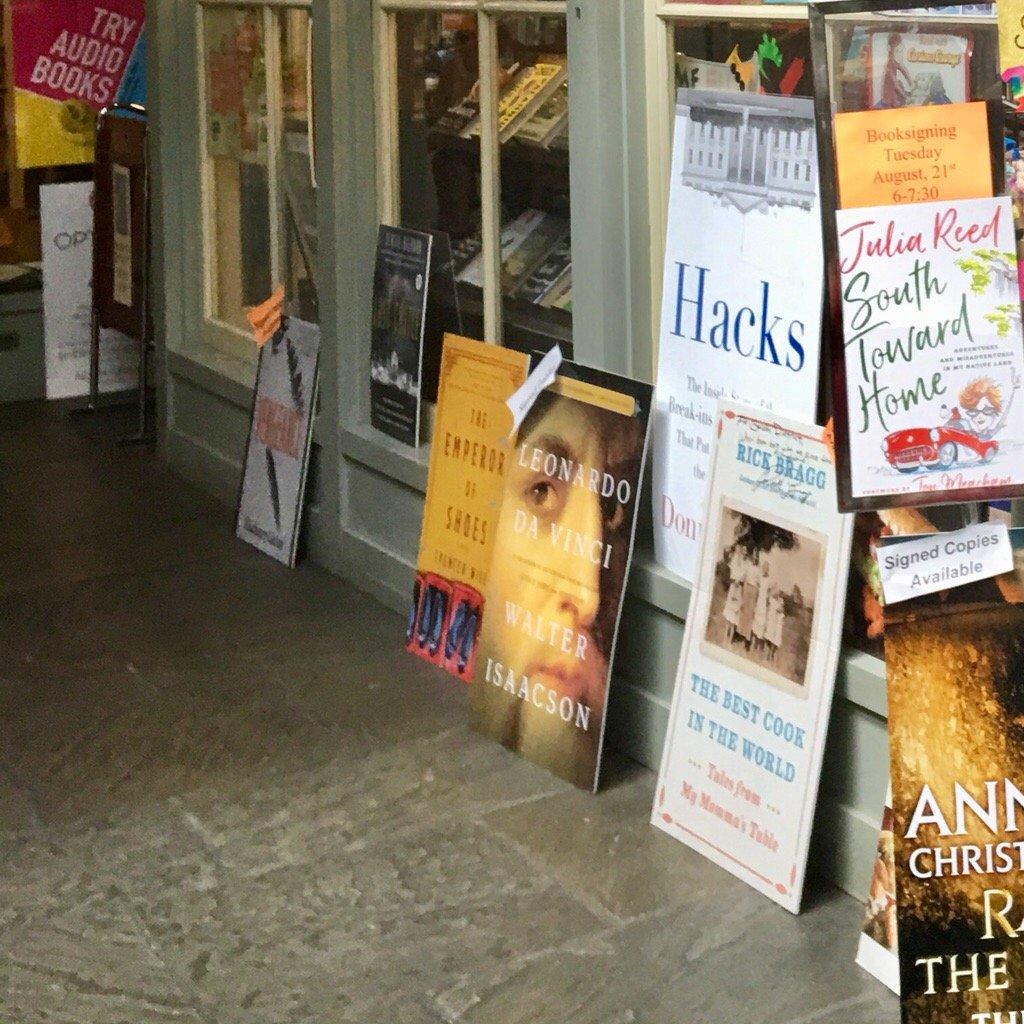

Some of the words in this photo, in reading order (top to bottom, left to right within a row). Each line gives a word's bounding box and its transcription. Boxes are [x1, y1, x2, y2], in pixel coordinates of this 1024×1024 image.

[90, 6, 136, 45] TRY
[50, 29, 124, 74] AUDIO
[30, 55, 114, 103] BOOKS
[867, 124, 957, 143] Booksigning
[883, 146, 943, 162] Tuesday
[873, 169, 928, 185] August,
[892, 186, 939, 203] 6-7:30
[53, 230, 91, 251] OP
[839, 220, 926, 273] Julia
[934, 206, 1001, 252] Reed
[670, 261, 805, 373] Hacks
[844, 260, 947, 331] South
[844, 292, 974, 382] Toward
[687, 376, 701, 393] The
[858, 371, 947, 433] Home
[669, 396, 713, 427] Break-ins
[444, 432, 506, 476] EMPEROR
[677, 429, 695, 448] That
[517, 443, 632, 504] LEONARDO
[736, 443, 772, 470] RICK
[775, 455, 826, 490] BRAGG
[446, 506, 488, 546] SHOES
[513, 509, 539, 540] DA
[550, 522, 614, 570] VINCI
[662, 494, 702, 540] Don
[884, 545, 940, 571] Signed
[944, 533, 1000, 556] Copies
[910, 561, 983, 589] Available
[504, 600, 589, 661] WALTER
[485, 657, 592, 732] ISAACSON
[690, 672, 720, 704] THE
[722, 688, 761, 723] BEST
[763, 710, 807, 750] COOK
[687, 709, 706, 732] IN
[709, 720, 739, 753] THE
[743, 737, 797, 783] WORLD
[915, 951, 1011, 995] THE
